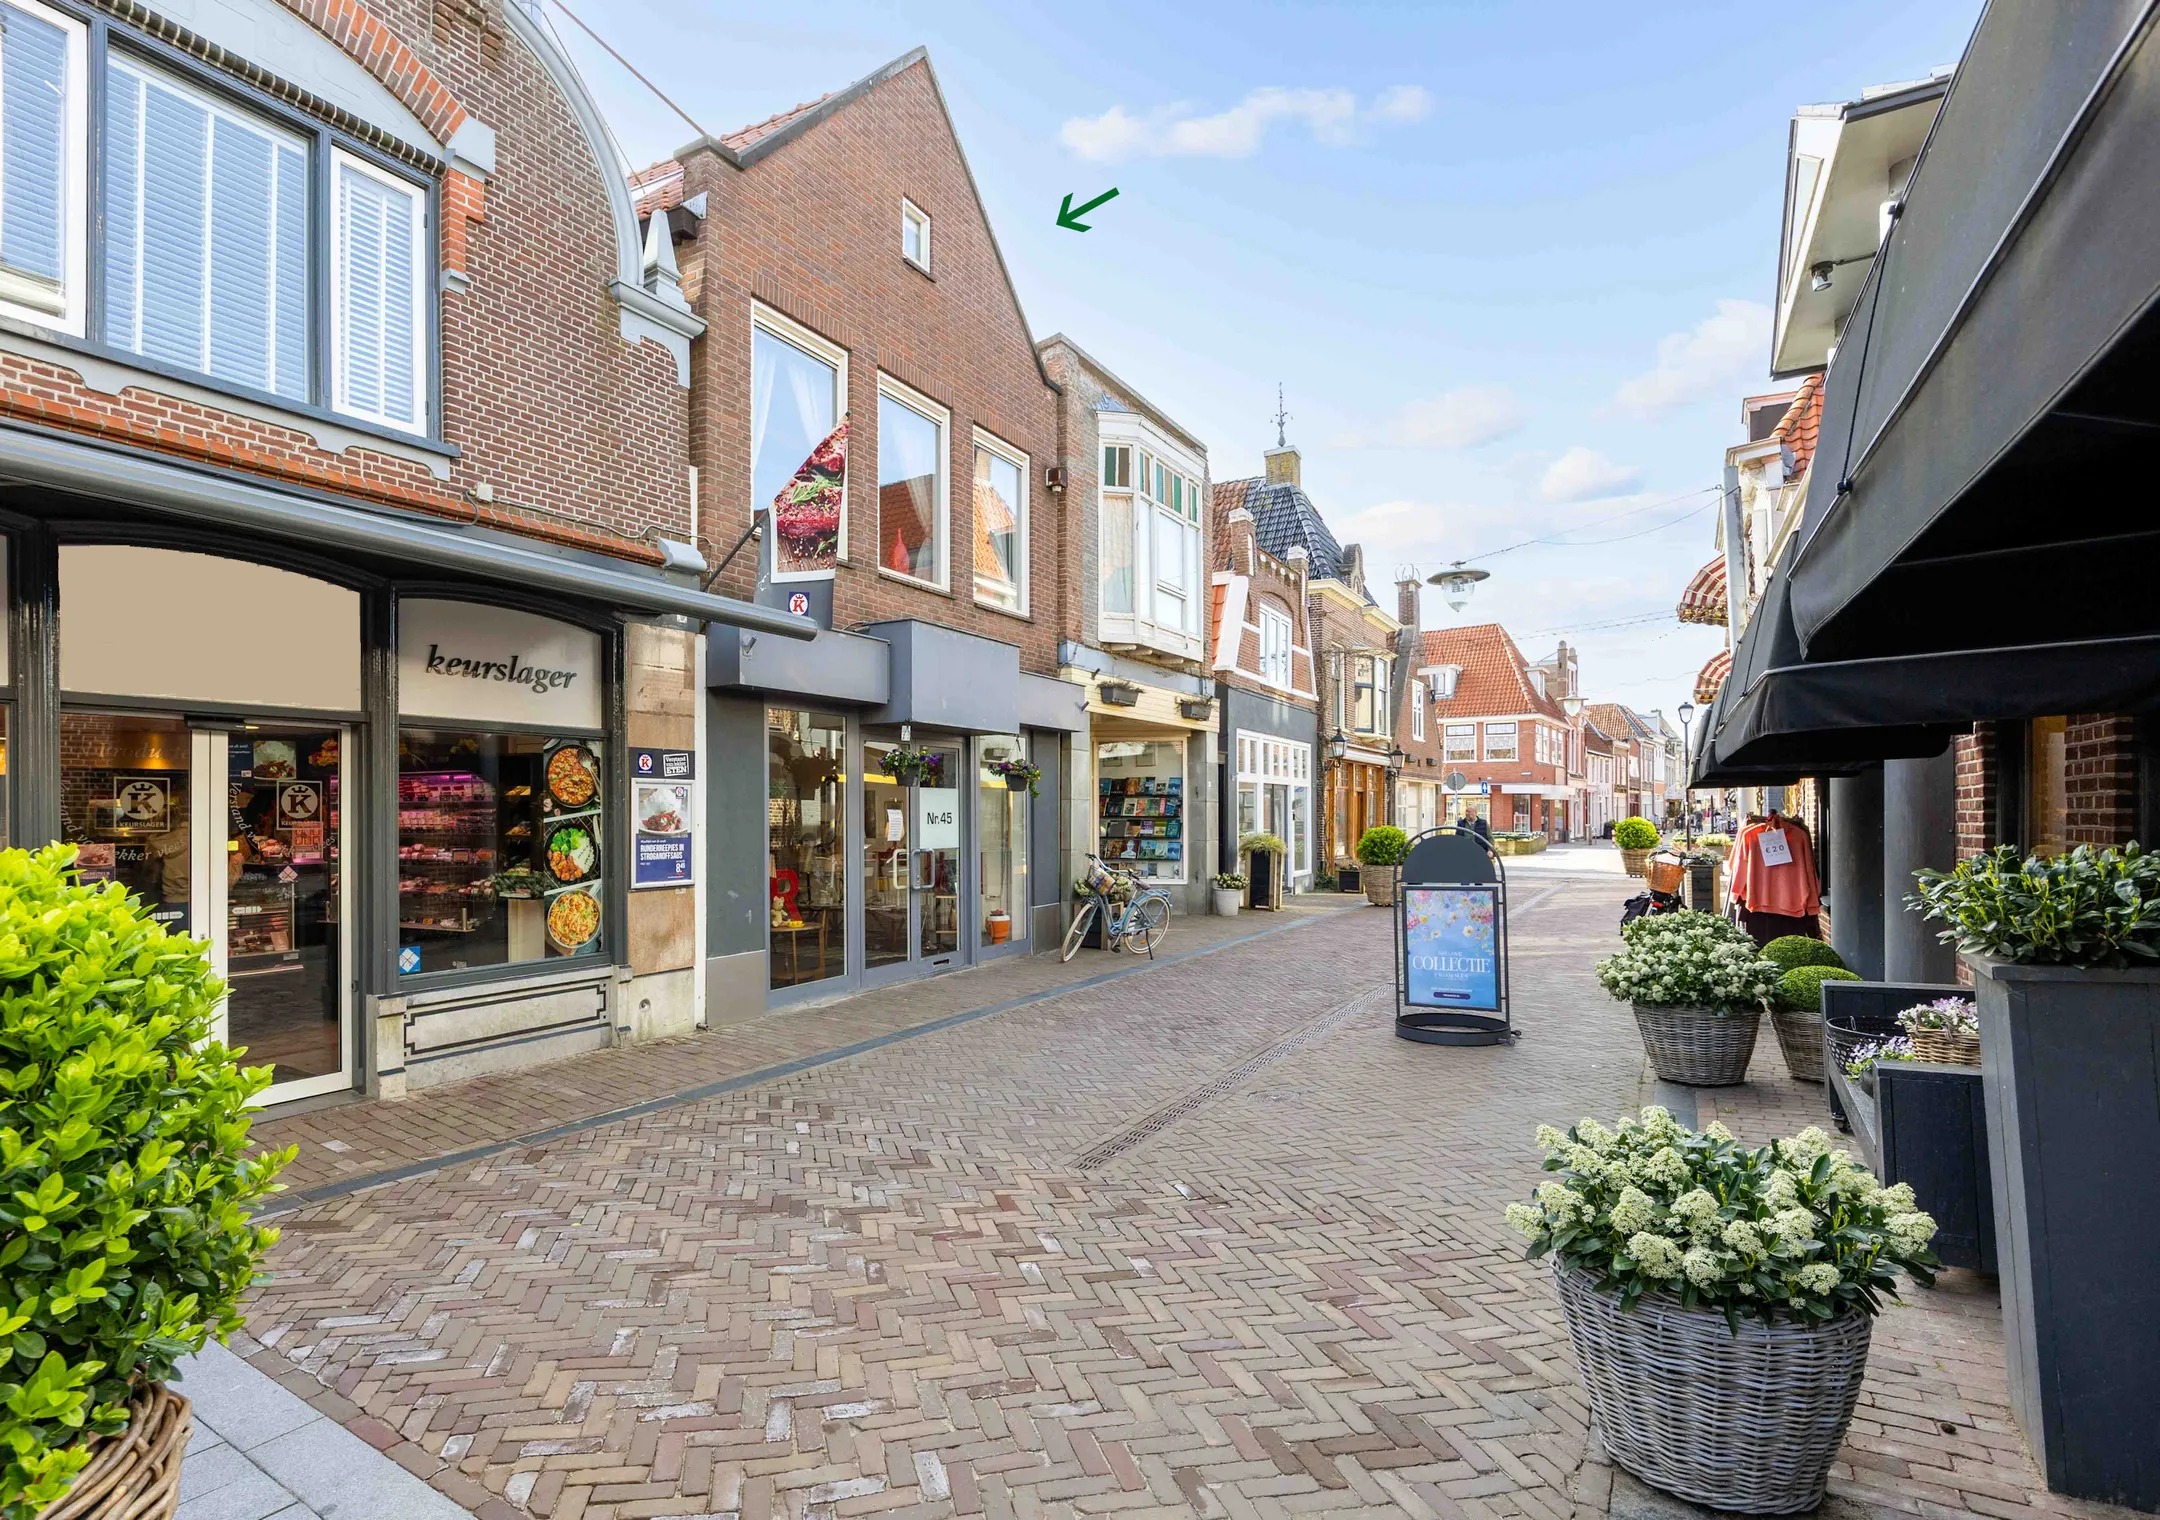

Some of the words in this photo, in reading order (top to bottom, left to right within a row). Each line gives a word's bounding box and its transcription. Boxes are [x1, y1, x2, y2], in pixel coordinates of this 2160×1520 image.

[793, 599, 805, 612] K
[425, 644, 577, 693] keurslager
[666, 766, 687, 774] ETEN
[128, 793, 157, 814] K
[229, 782, 252, 832] Verstand
[288, 794, 312, 814] K
[114, 849, 151, 861] ekker
[157, 840, 186, 857] vlees
[1412, 956, 1491, 973] COLLECTIE
